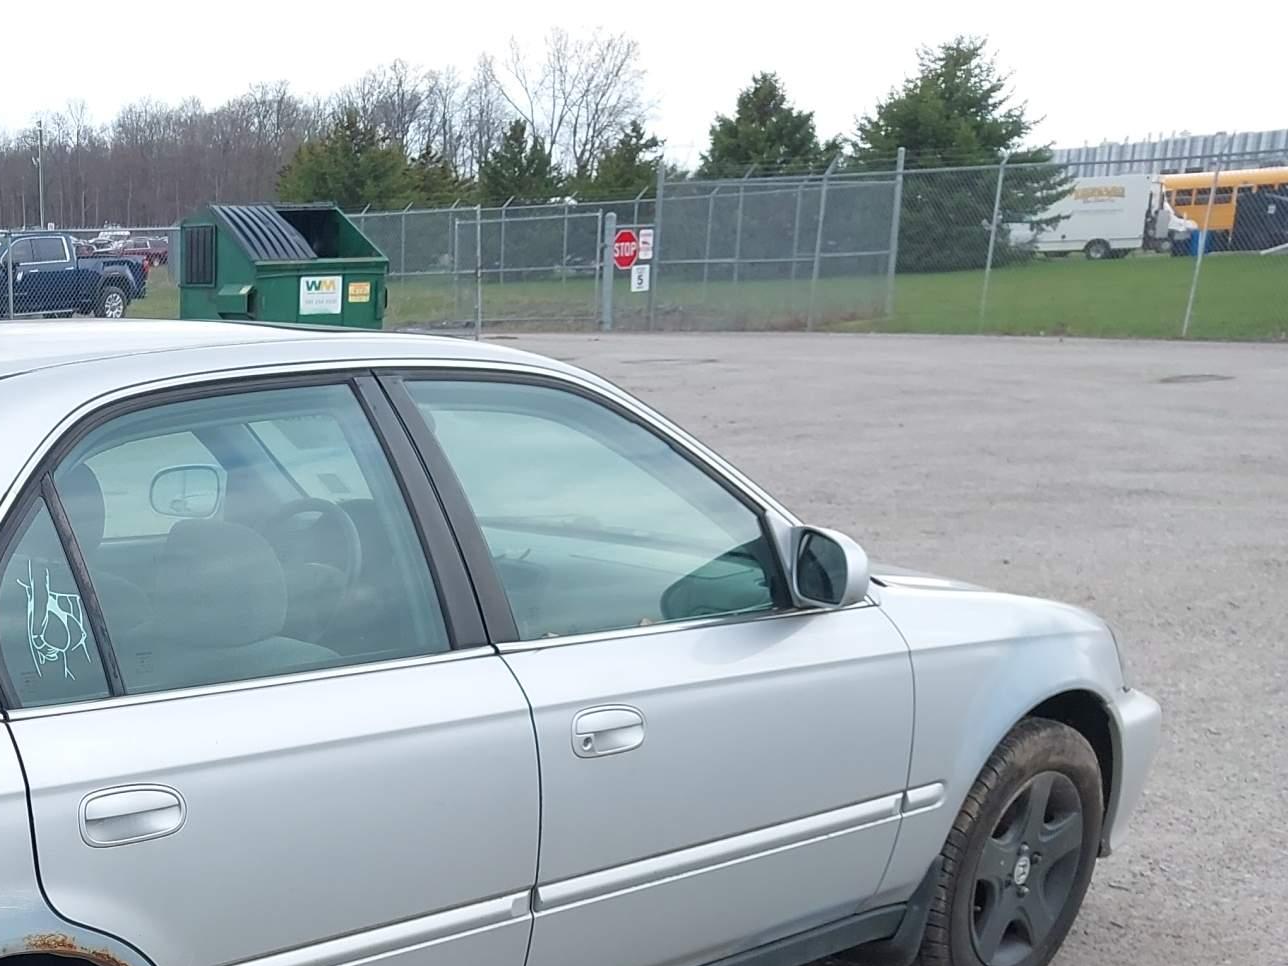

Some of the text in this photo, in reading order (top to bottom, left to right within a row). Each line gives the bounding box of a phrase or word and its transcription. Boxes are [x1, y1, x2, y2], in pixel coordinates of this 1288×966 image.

[614, 242, 637, 257] STOP
[305, 280, 336, 292] WM
[636, 274, 644, 286] 5
